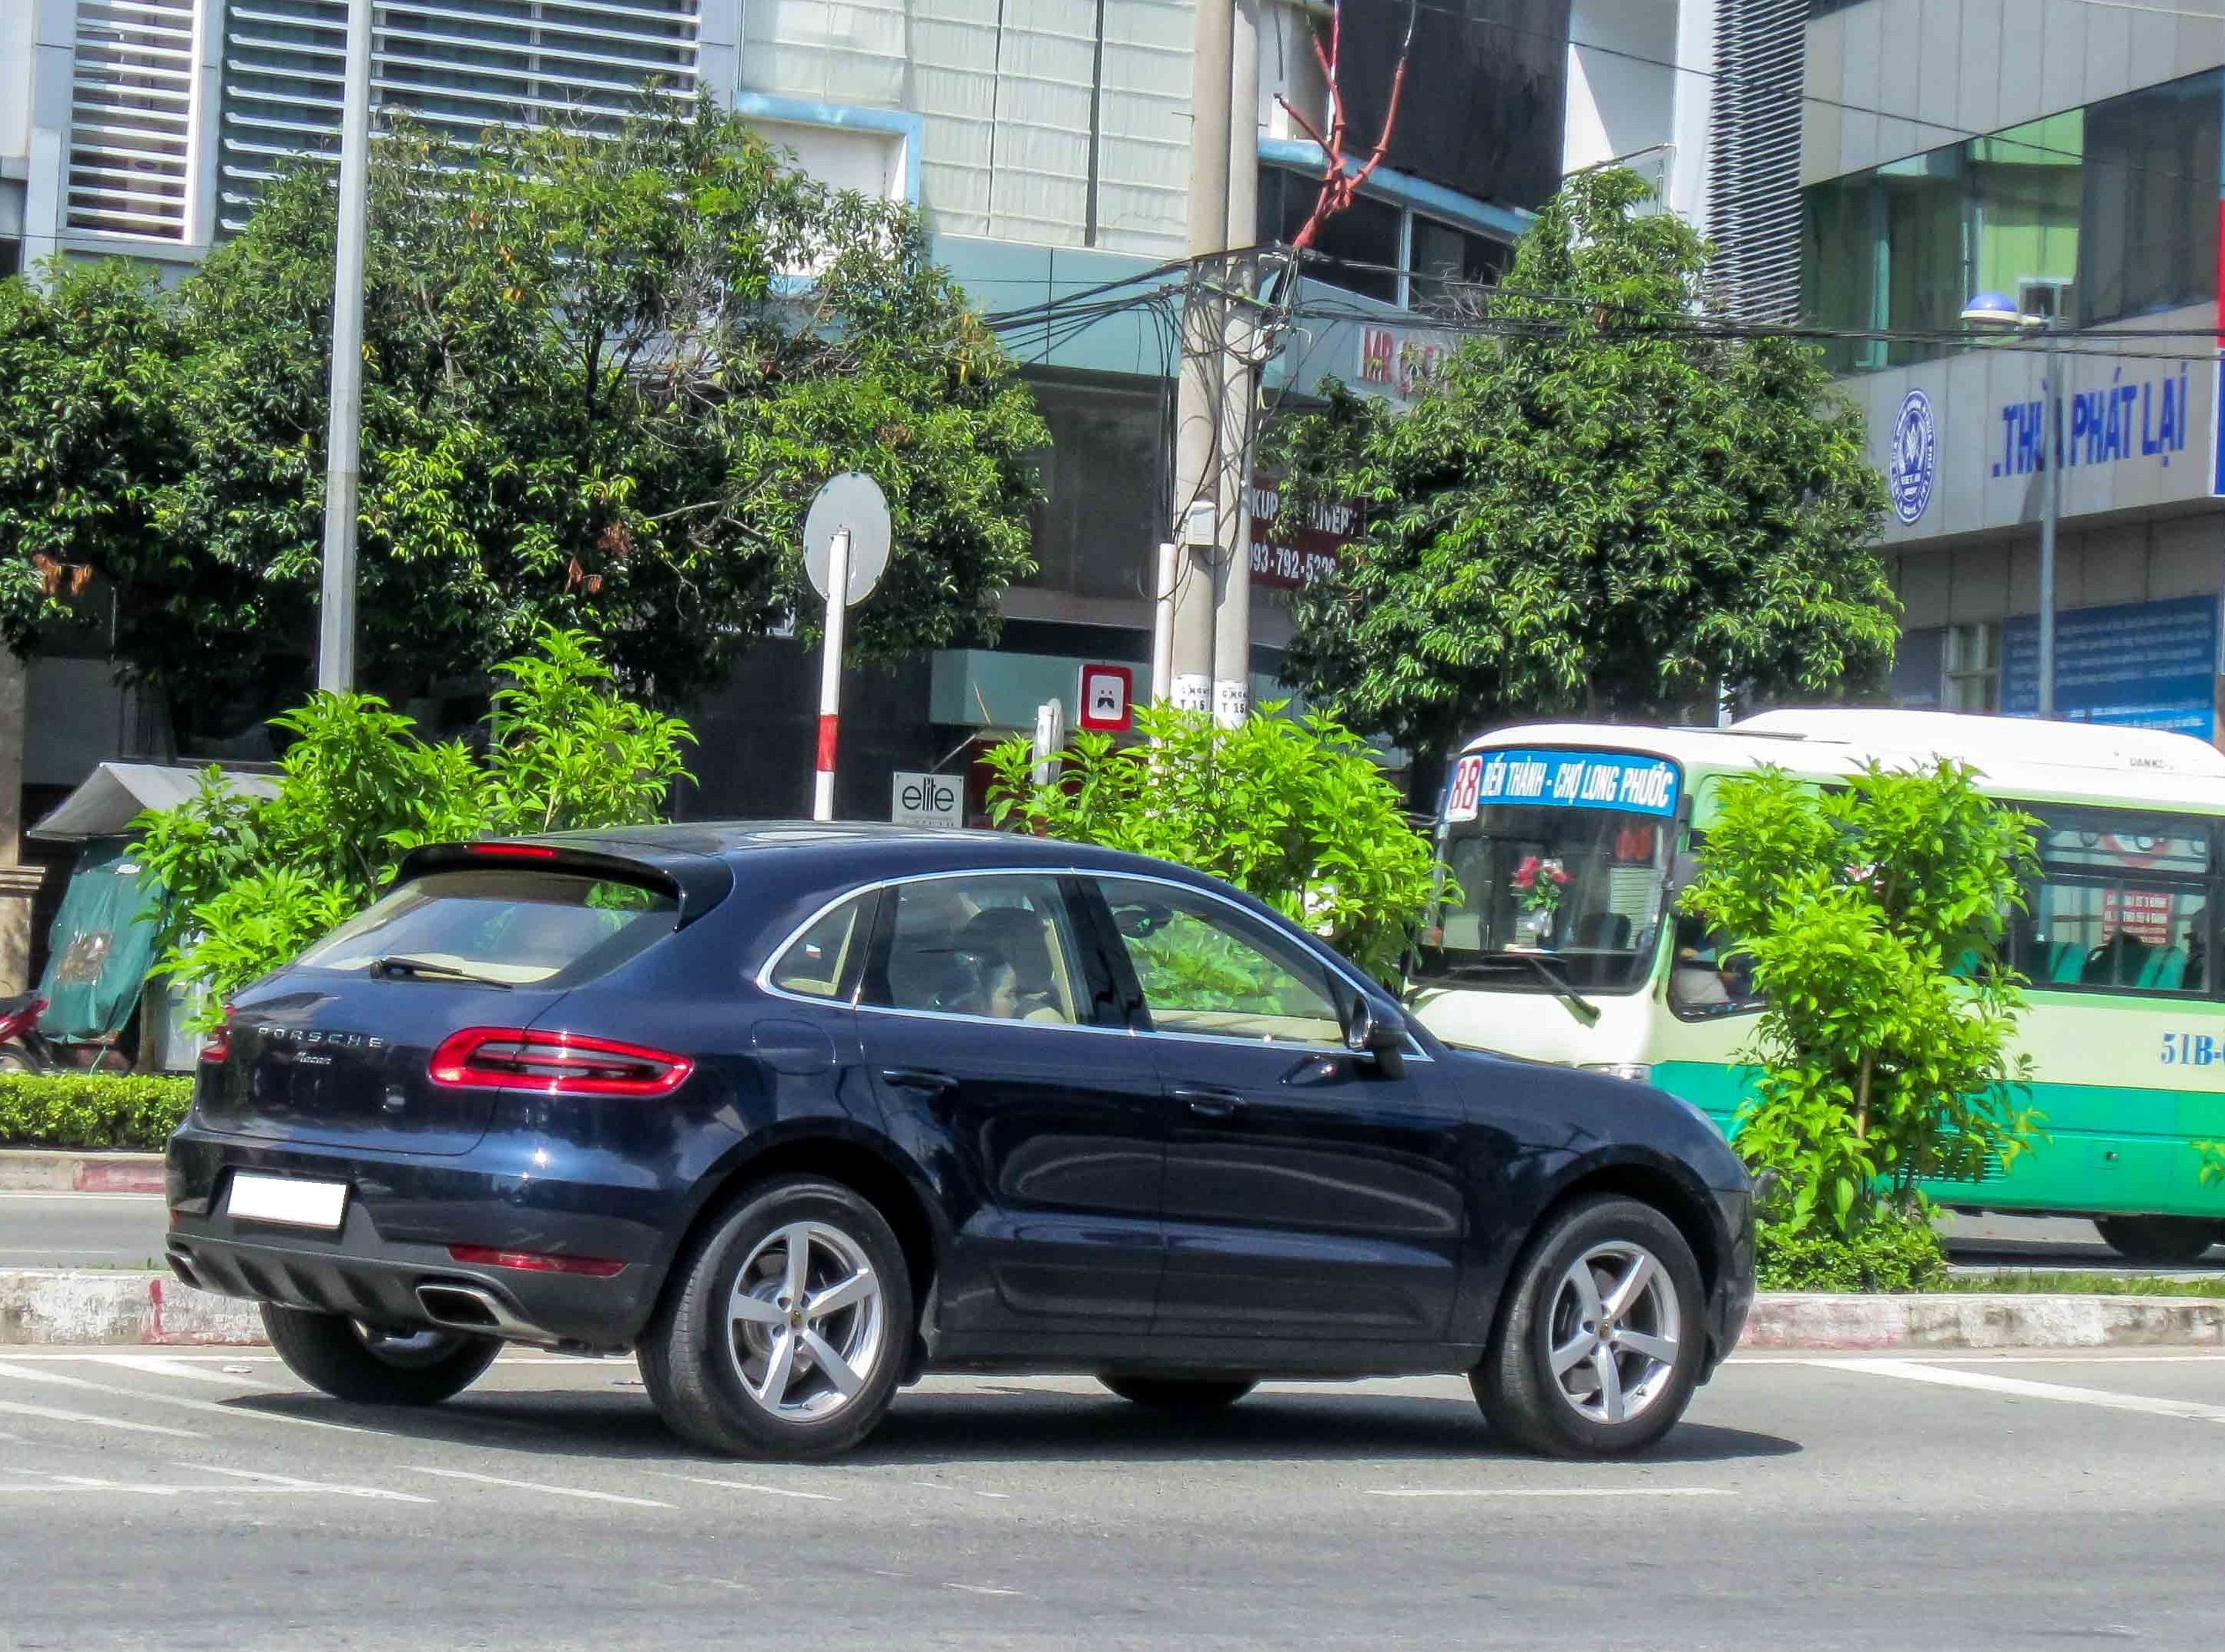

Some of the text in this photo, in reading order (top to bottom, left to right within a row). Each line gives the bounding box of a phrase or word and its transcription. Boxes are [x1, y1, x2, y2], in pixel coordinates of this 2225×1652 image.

[2072, 367, 2137, 467] PHÁT
[902, 777, 955, 813] elite
[1451, 759, 1481, 809] 88
[1506, 755, 1547, 796] THÀNH
[1553, 759, 1585, 805] CHỢ
[1580, 764, 1620, 802] LONG
[258, 1027, 384, 1047] PORSCHE
[2160, 1033, 2225, 1066] 51B-
